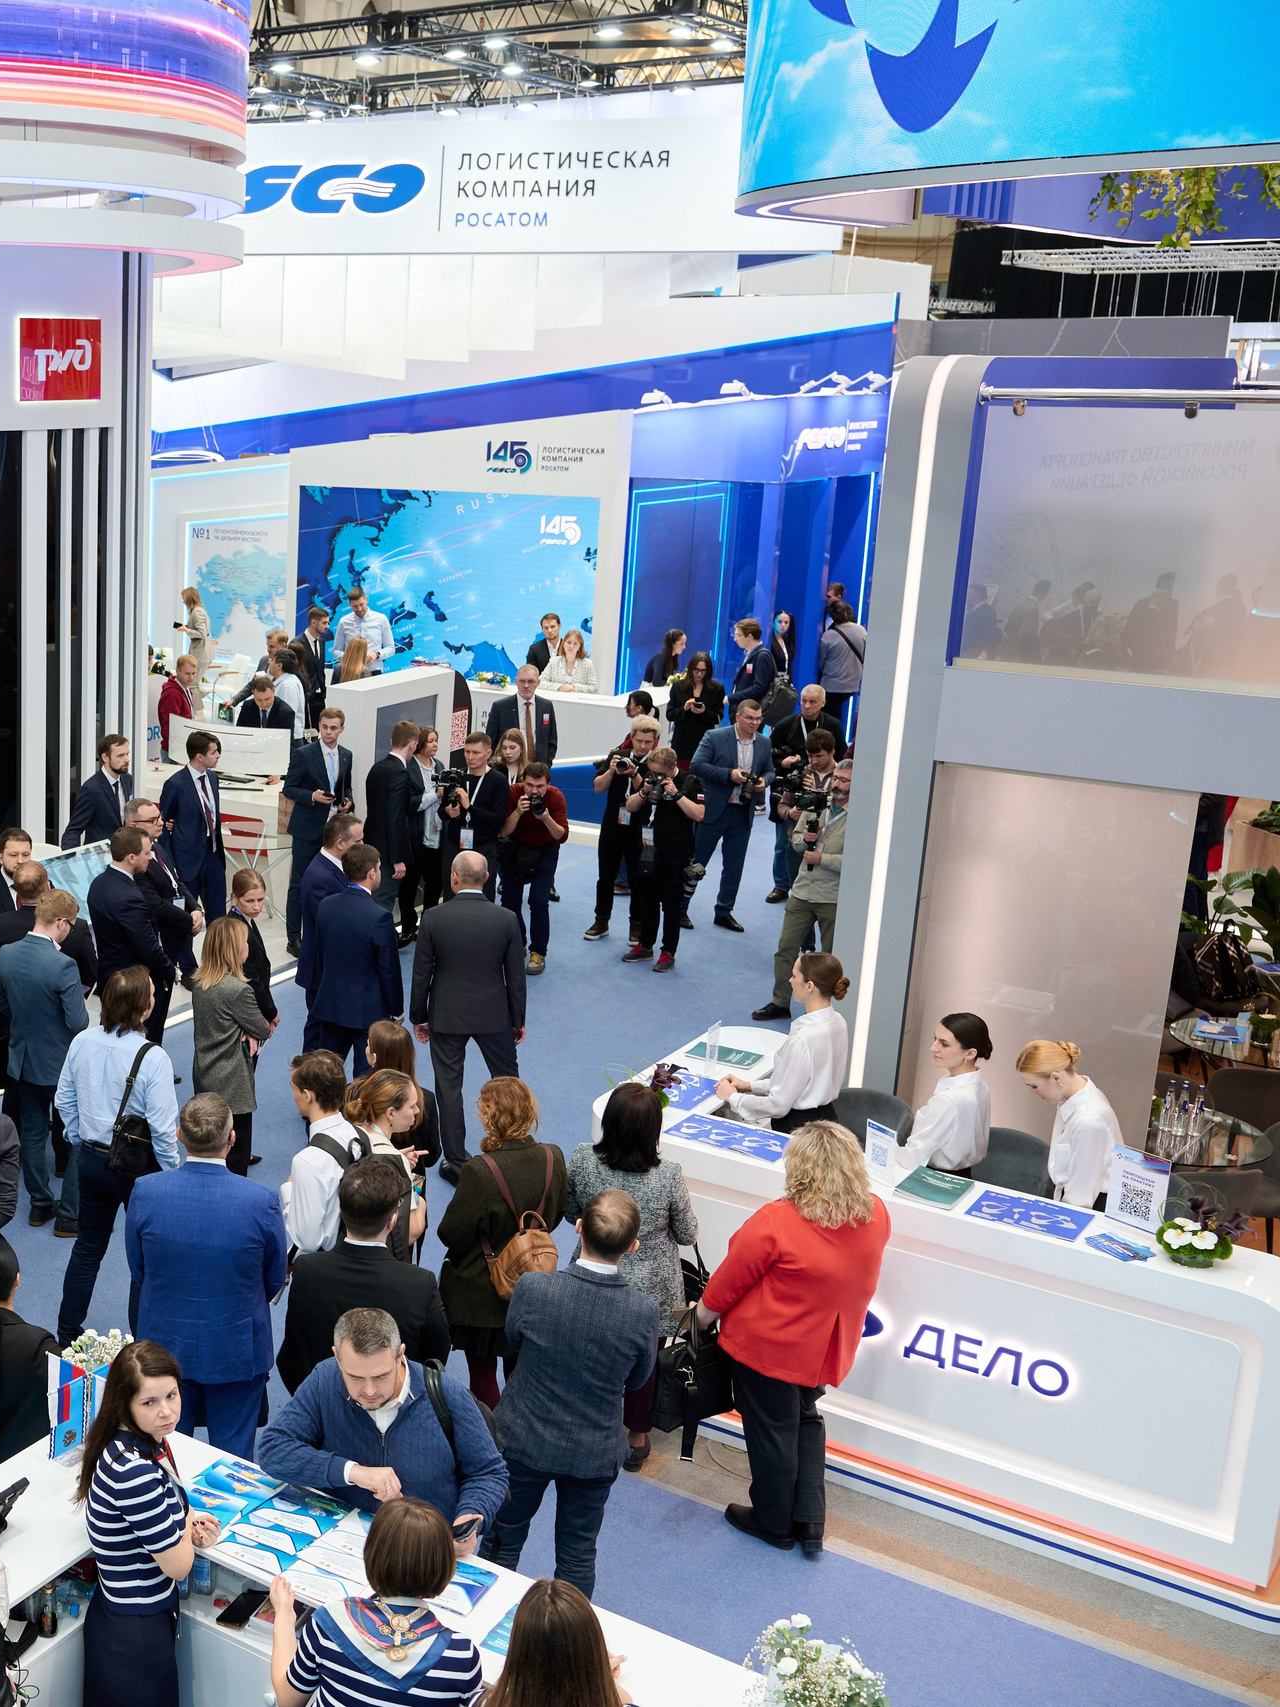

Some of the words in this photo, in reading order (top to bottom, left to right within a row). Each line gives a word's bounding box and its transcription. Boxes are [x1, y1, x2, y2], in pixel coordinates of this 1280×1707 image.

[457, 150, 671, 171] ЛОГИСТИЧЕСКАЯ
[244, 163, 426, 214] SCO
[457, 179, 596, 199] КОМПАНИЯ
[454, 211, 549, 228] РОСАТОМ
[542, 446, 605, 455] ЛОГИСТИЧЕСКАЯ
[520, 576, 561, 595] CHINA
[395, 623, 416, 634] TURKEY
[444, 624, 458, 632] IRAN
[1123, 1170, 1156, 1184] ПРИГЛАШАЕМ
[1129, 1176, 1155, 1188] ПРАКТИКУ
[903, 1323, 1070, 1397] ДЕЛО
